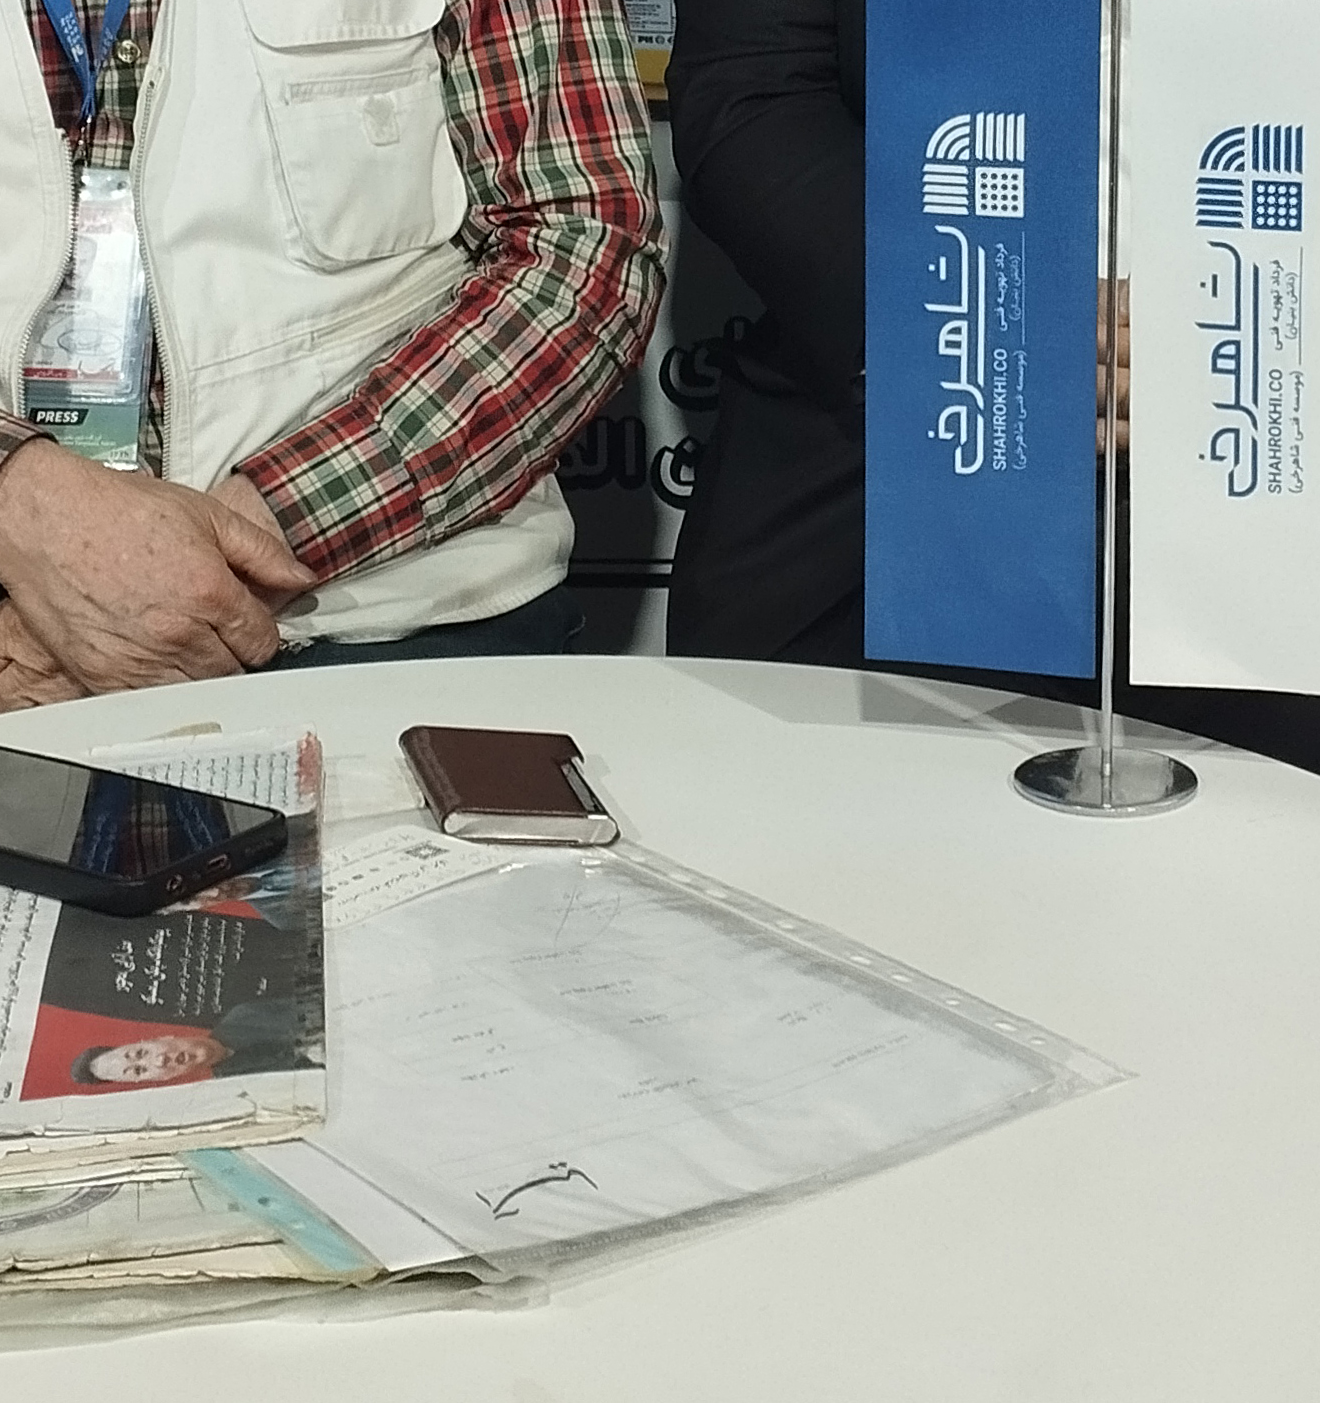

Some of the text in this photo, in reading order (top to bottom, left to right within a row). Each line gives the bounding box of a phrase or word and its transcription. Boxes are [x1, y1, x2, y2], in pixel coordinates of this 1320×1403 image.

[1269, 326, 1282, 351] فنی
[36, 411, 80, 423] PRESS
[993, 349, 1008, 471] SHAHROKHI.CO
[1268, 369, 1283, 494] SHAHROKHI.CO
